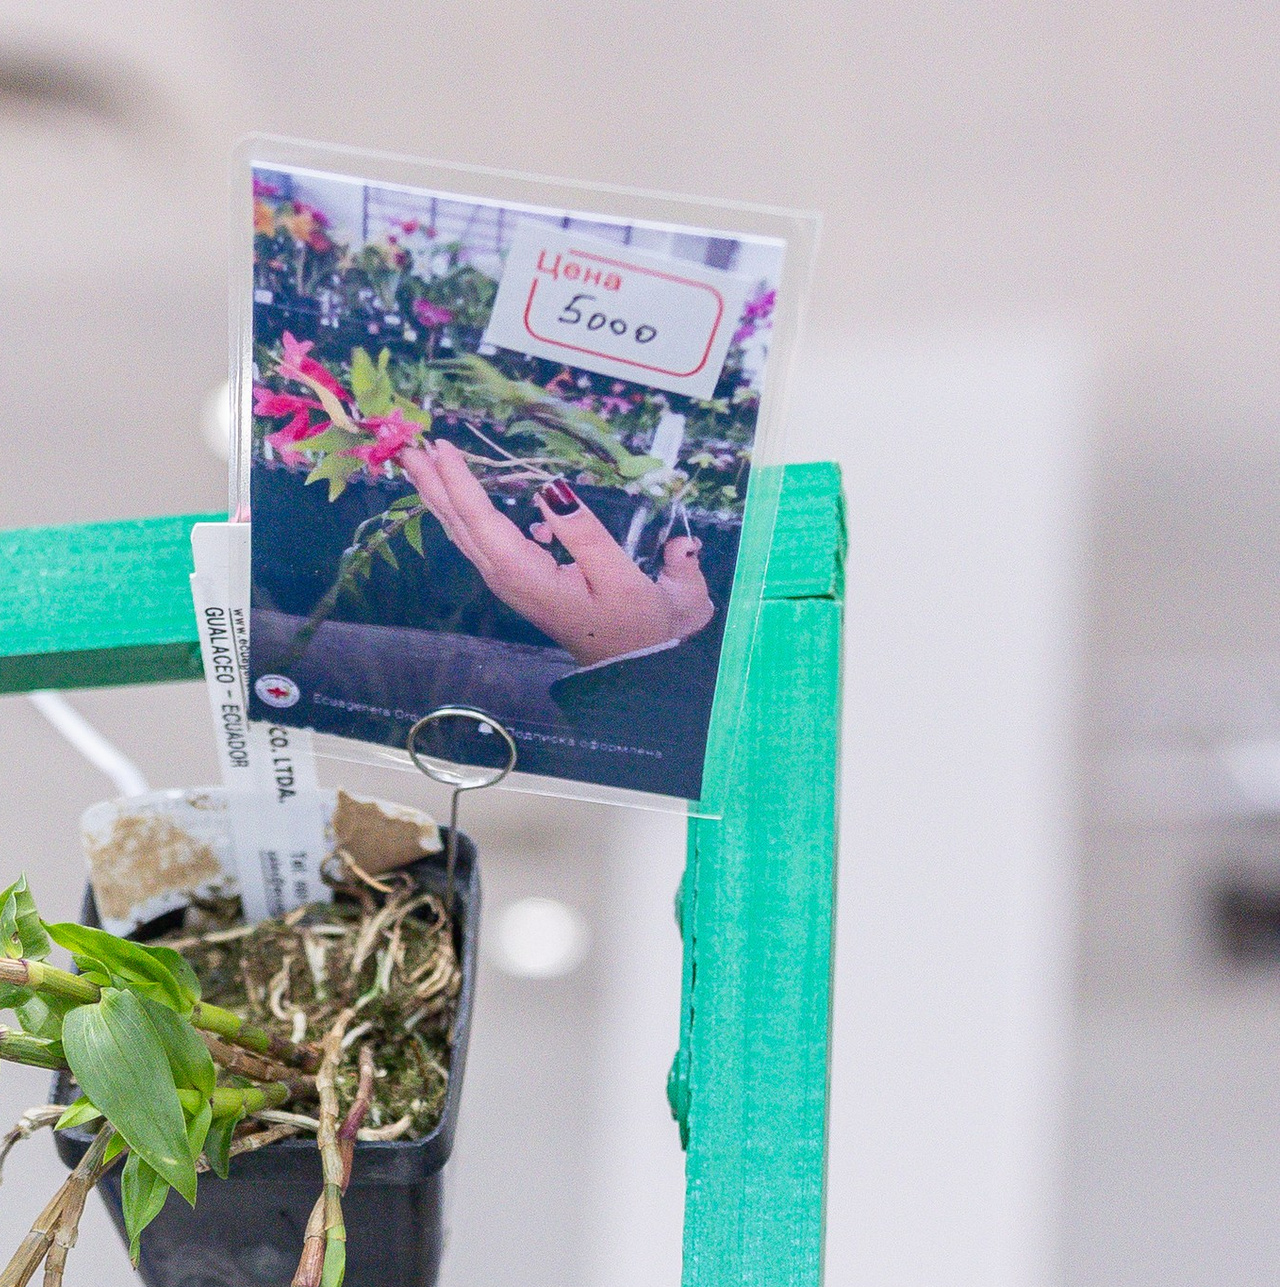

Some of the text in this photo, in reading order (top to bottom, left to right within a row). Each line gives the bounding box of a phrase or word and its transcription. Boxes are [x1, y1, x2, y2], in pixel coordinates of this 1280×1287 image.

[537, 249, 622, 292] Цена
[558, 293, 657, 344] 5000
[205, 606, 235, 684] GUALACEO
[222, 704, 250, 768] ECUADOR
[273, 757, 297, 804] LTDA.
